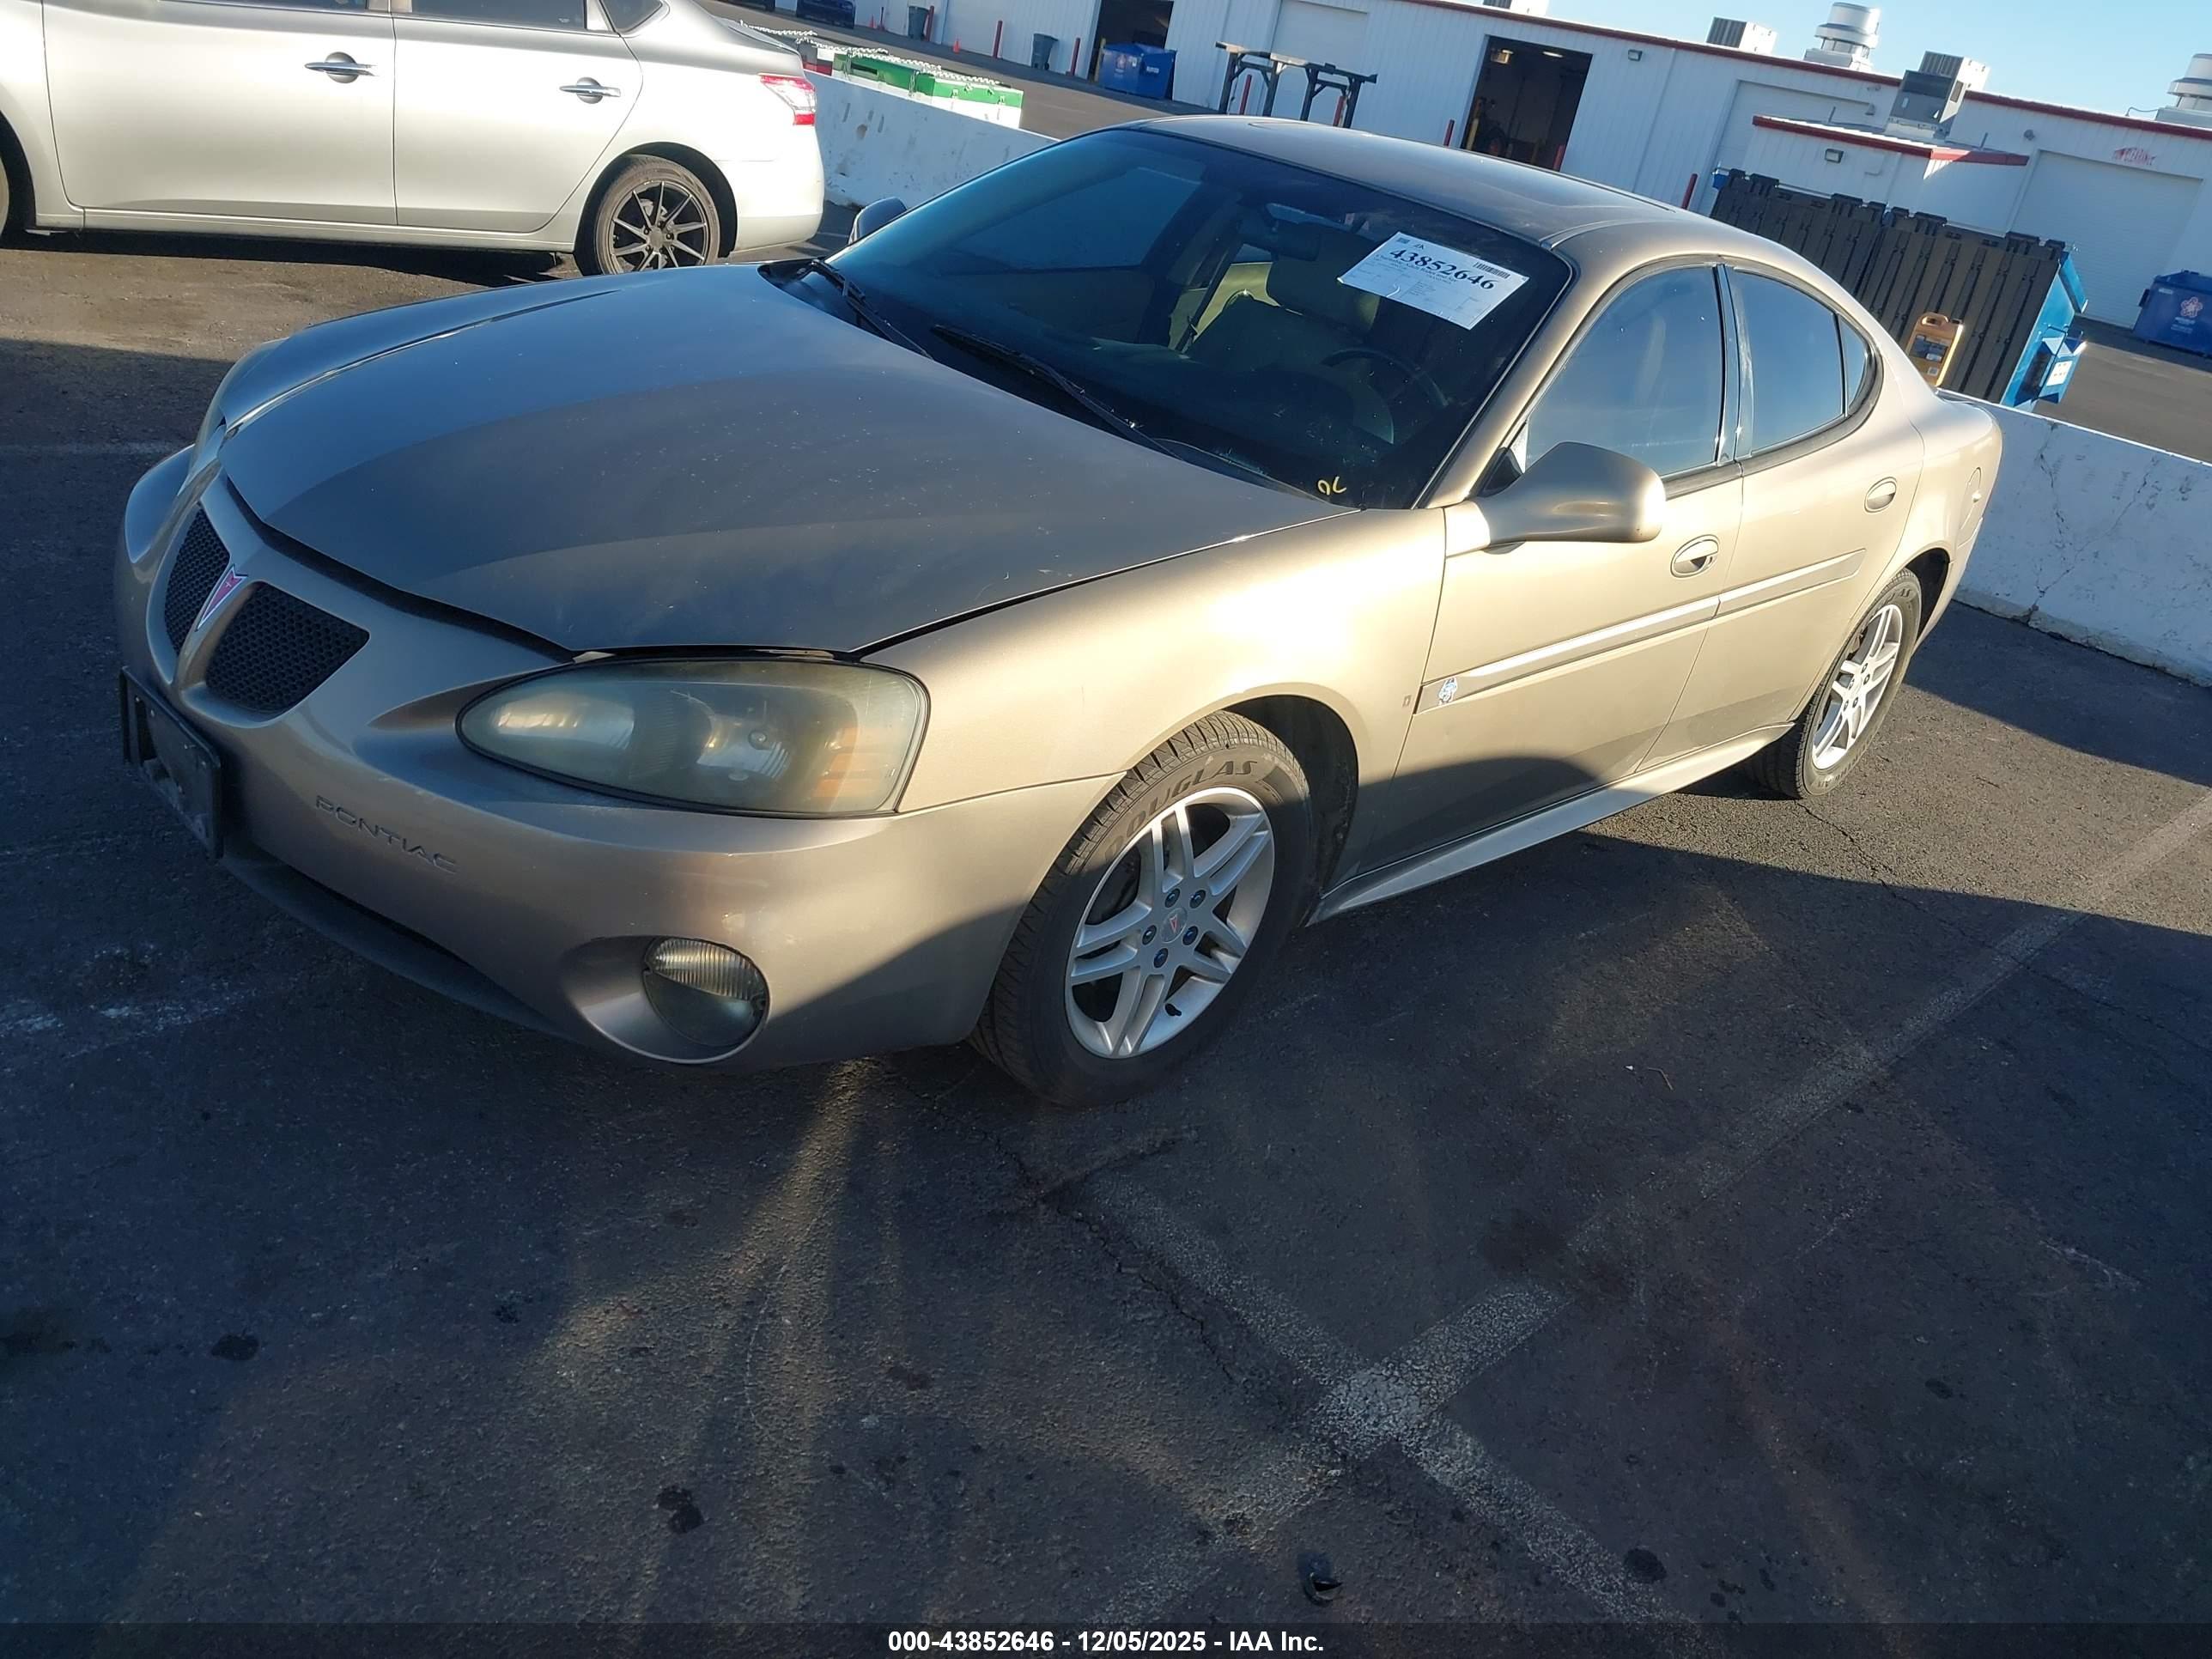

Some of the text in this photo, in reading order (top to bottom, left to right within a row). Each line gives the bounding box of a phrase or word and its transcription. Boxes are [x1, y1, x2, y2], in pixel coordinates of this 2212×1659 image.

[1390, 249, 1498, 290] 43852646
[315, 794, 458, 874] PONTIAC
[1104, 760, 1258, 862] DOUGLAS
